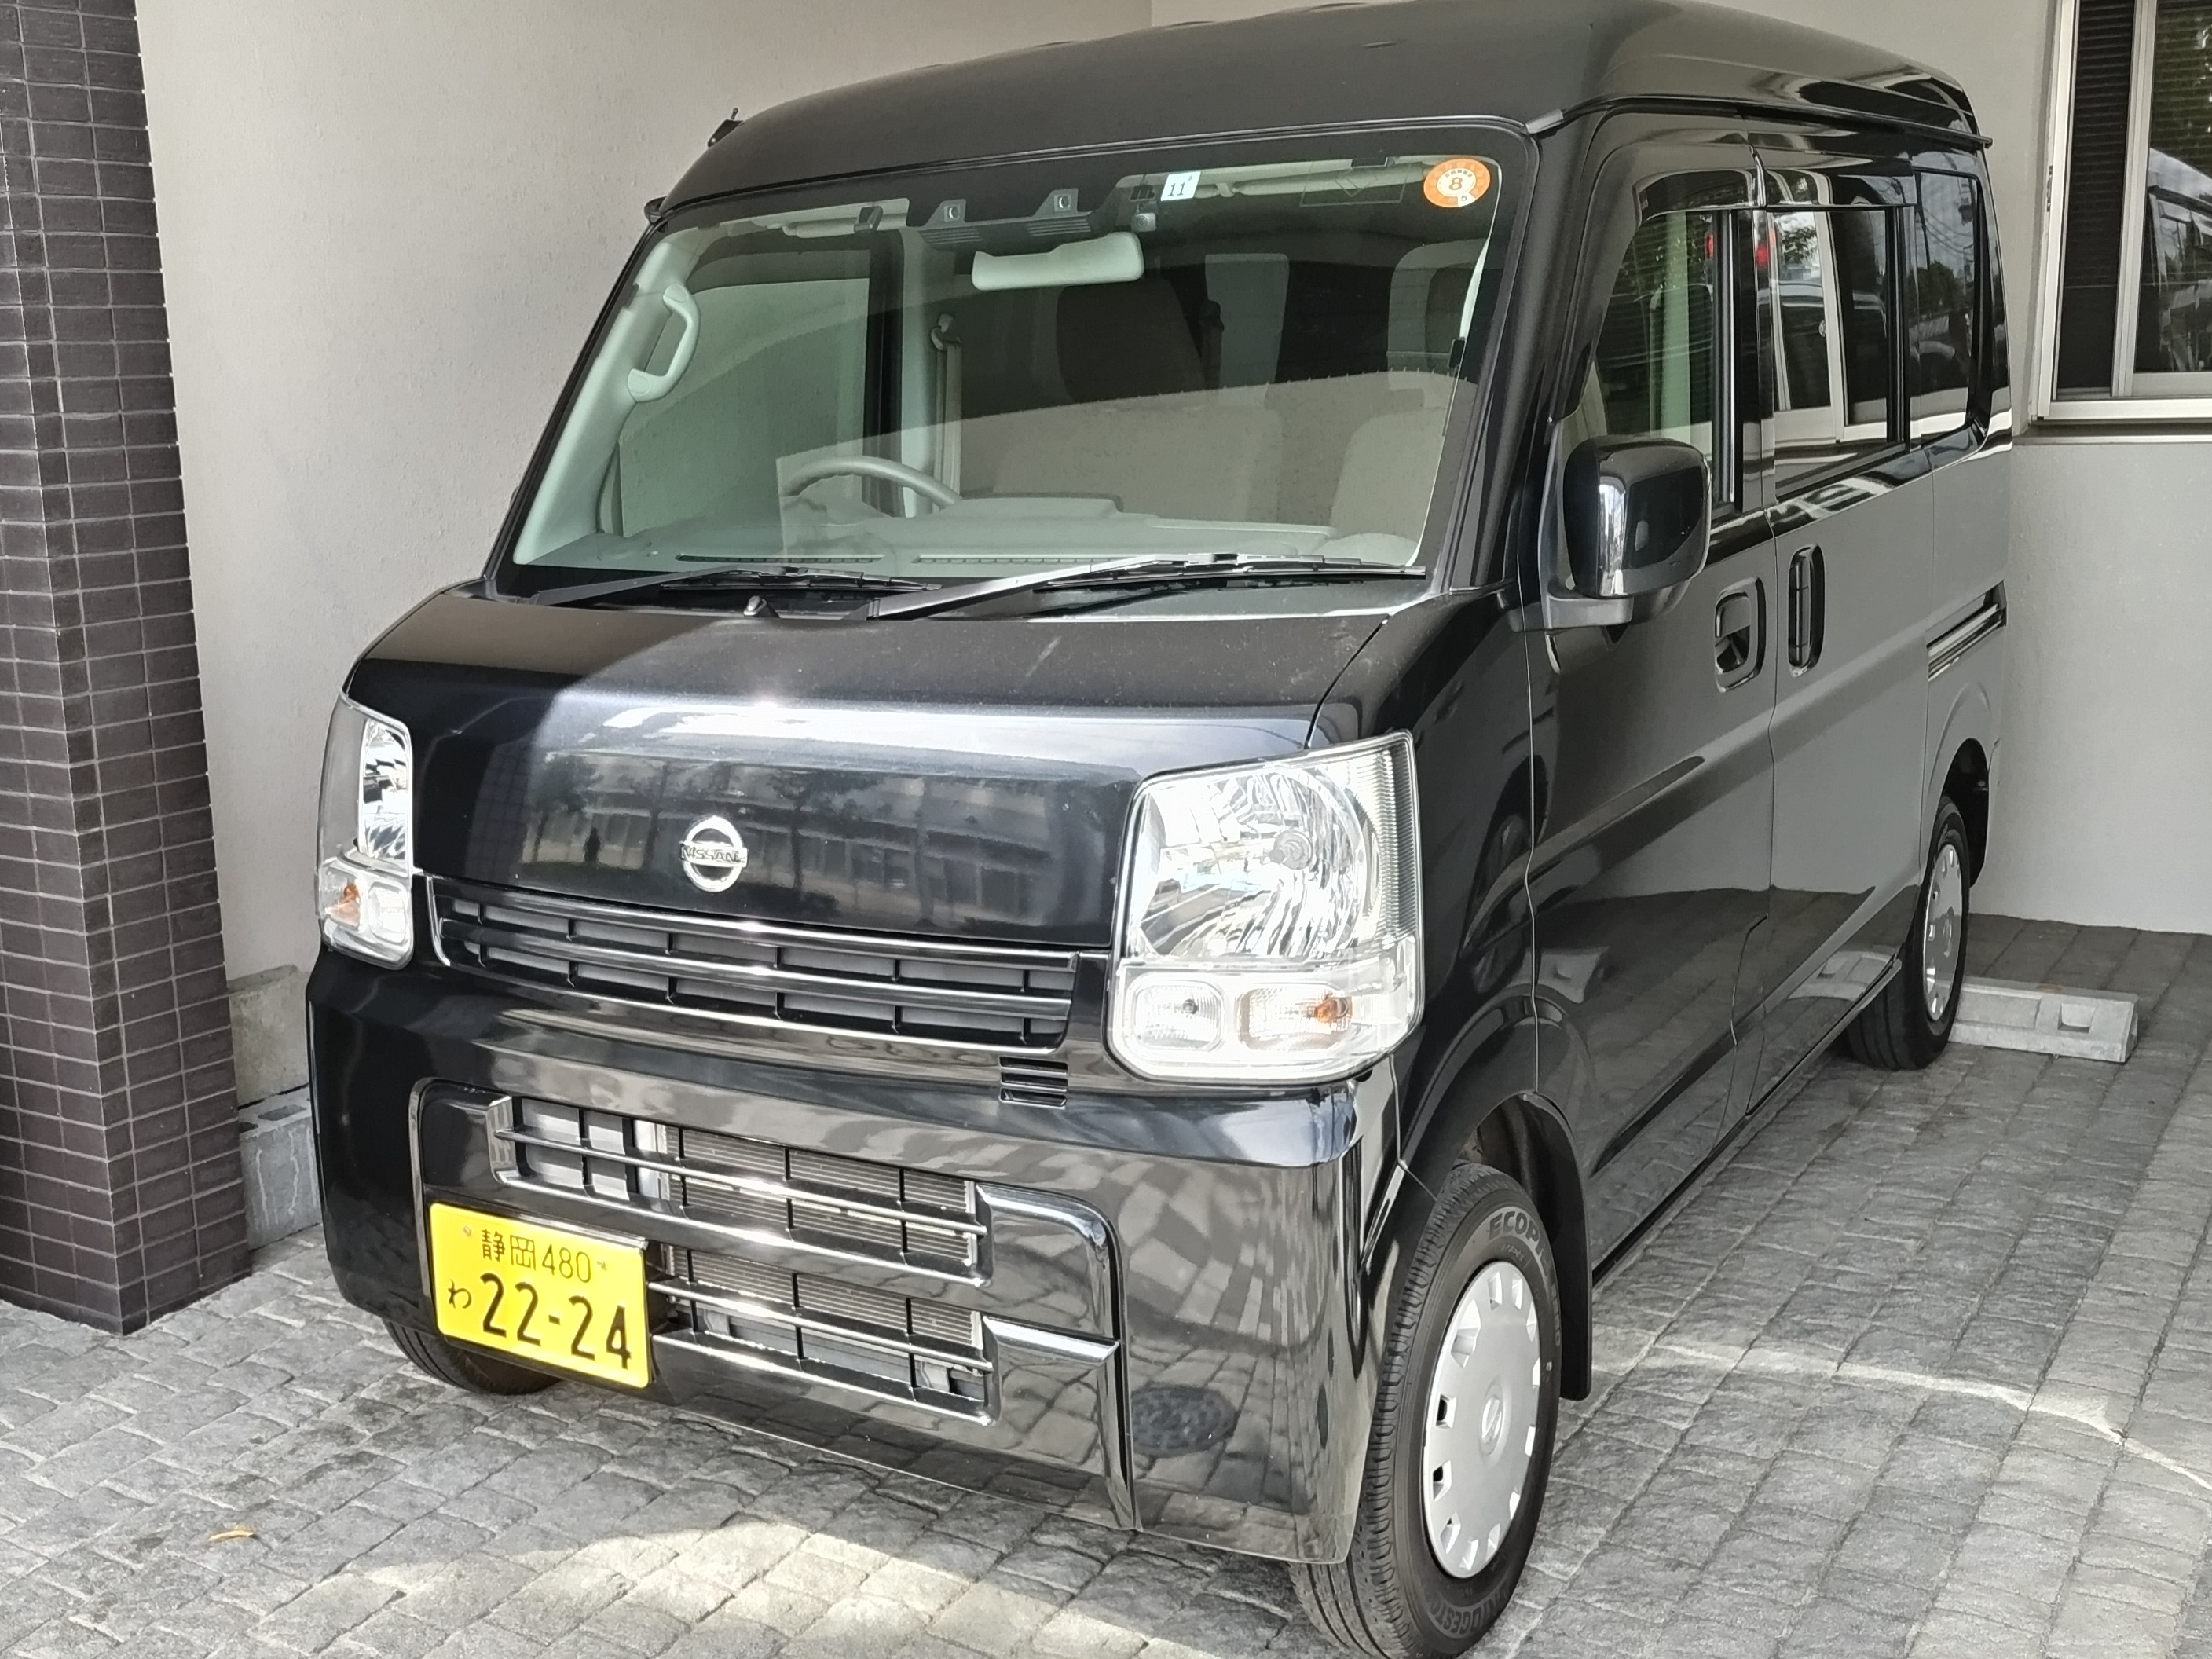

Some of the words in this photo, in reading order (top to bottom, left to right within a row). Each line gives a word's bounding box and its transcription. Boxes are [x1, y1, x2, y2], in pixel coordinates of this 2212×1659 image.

[1167, 181, 1185, 197] 11
[1448, 176, 1463, 191] 8
[681, 844, 741, 863] NISSAN
[447, 1279, 472, 1309] わ
[480, 1273, 632, 1370] 22-24
